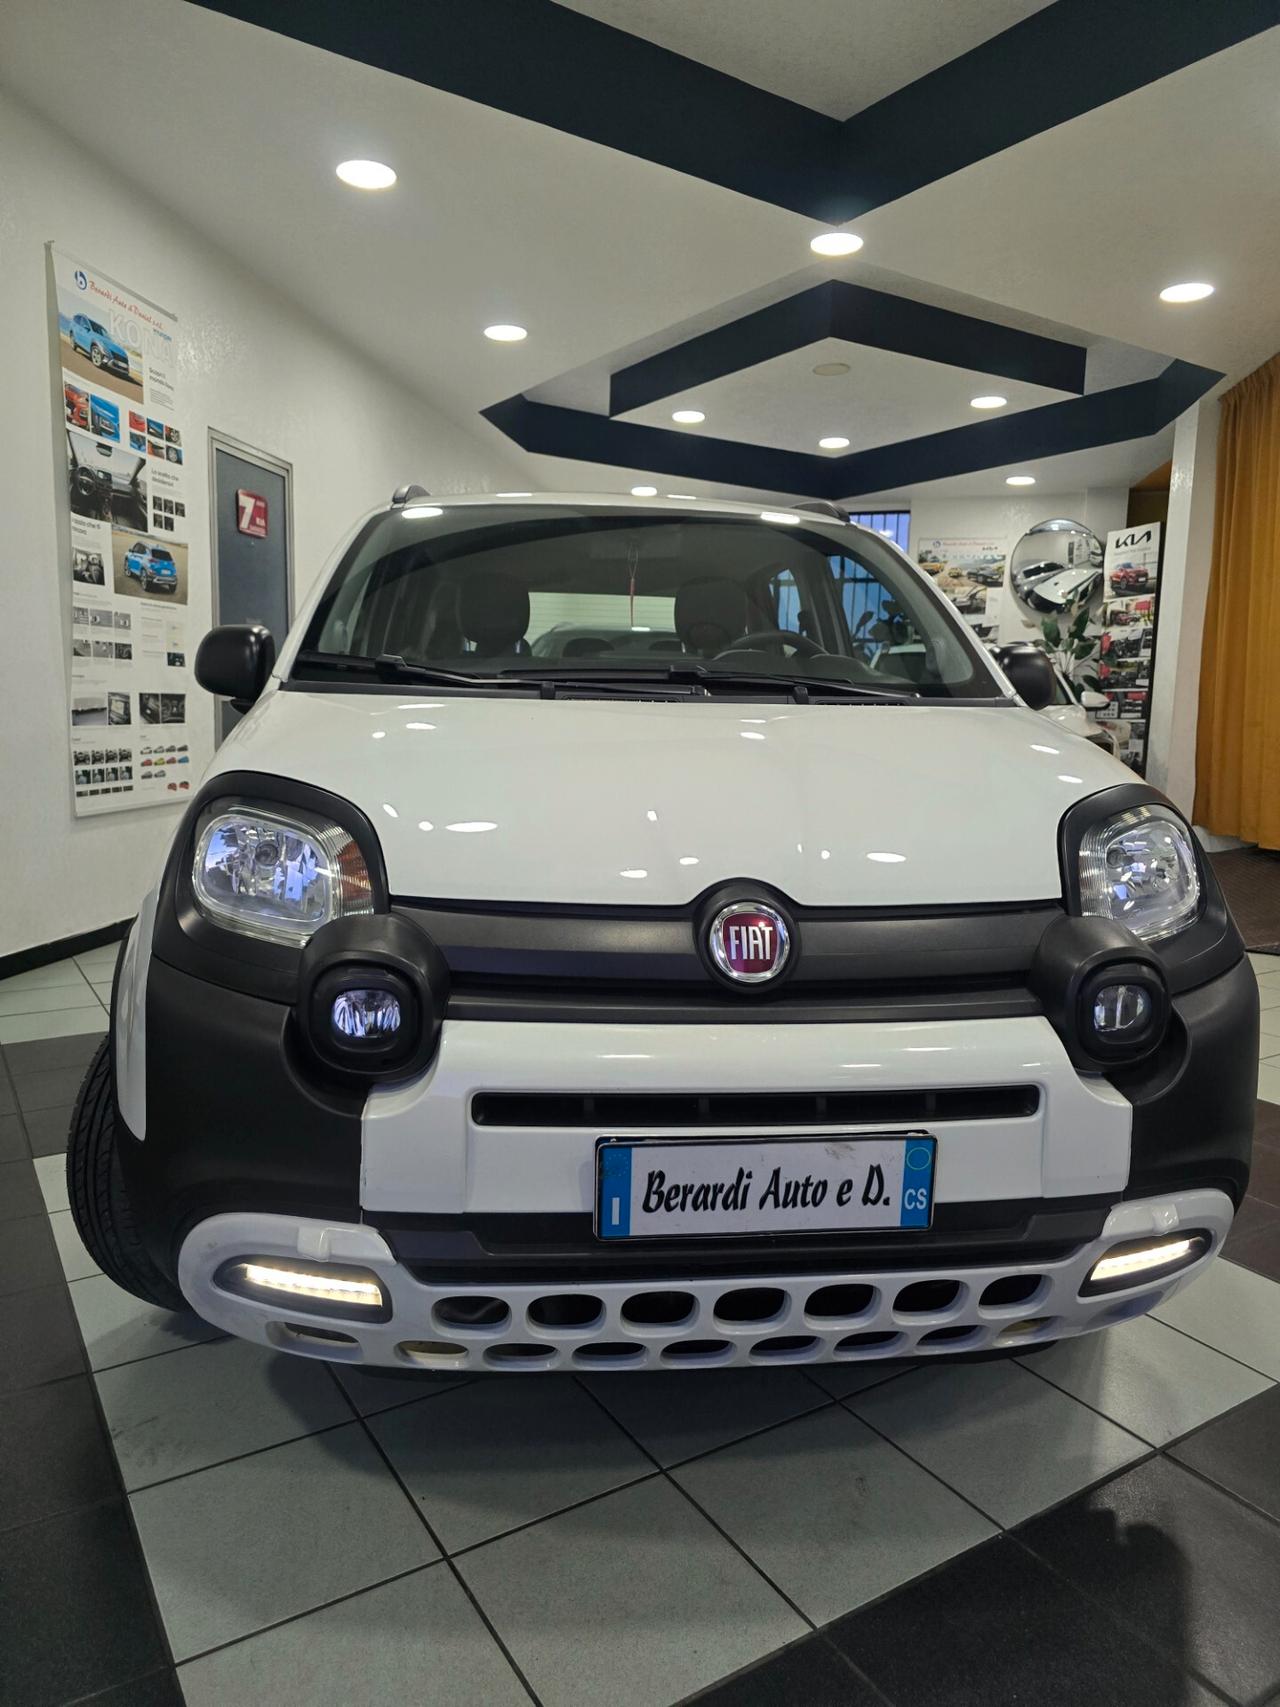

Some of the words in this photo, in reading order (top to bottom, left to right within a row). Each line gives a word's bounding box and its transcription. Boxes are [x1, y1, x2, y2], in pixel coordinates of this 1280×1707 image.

[1115, 530, 1152, 549] KIA
[728, 925, 774, 960] FIAT
[642, 1166, 753, 1213] Berardi
[758, 1166, 829, 1209] Auto
[836, 1178, 854, 1207] e
[861, 1163, 891, 1206] D.
[904, 1187, 928, 1210] CS
